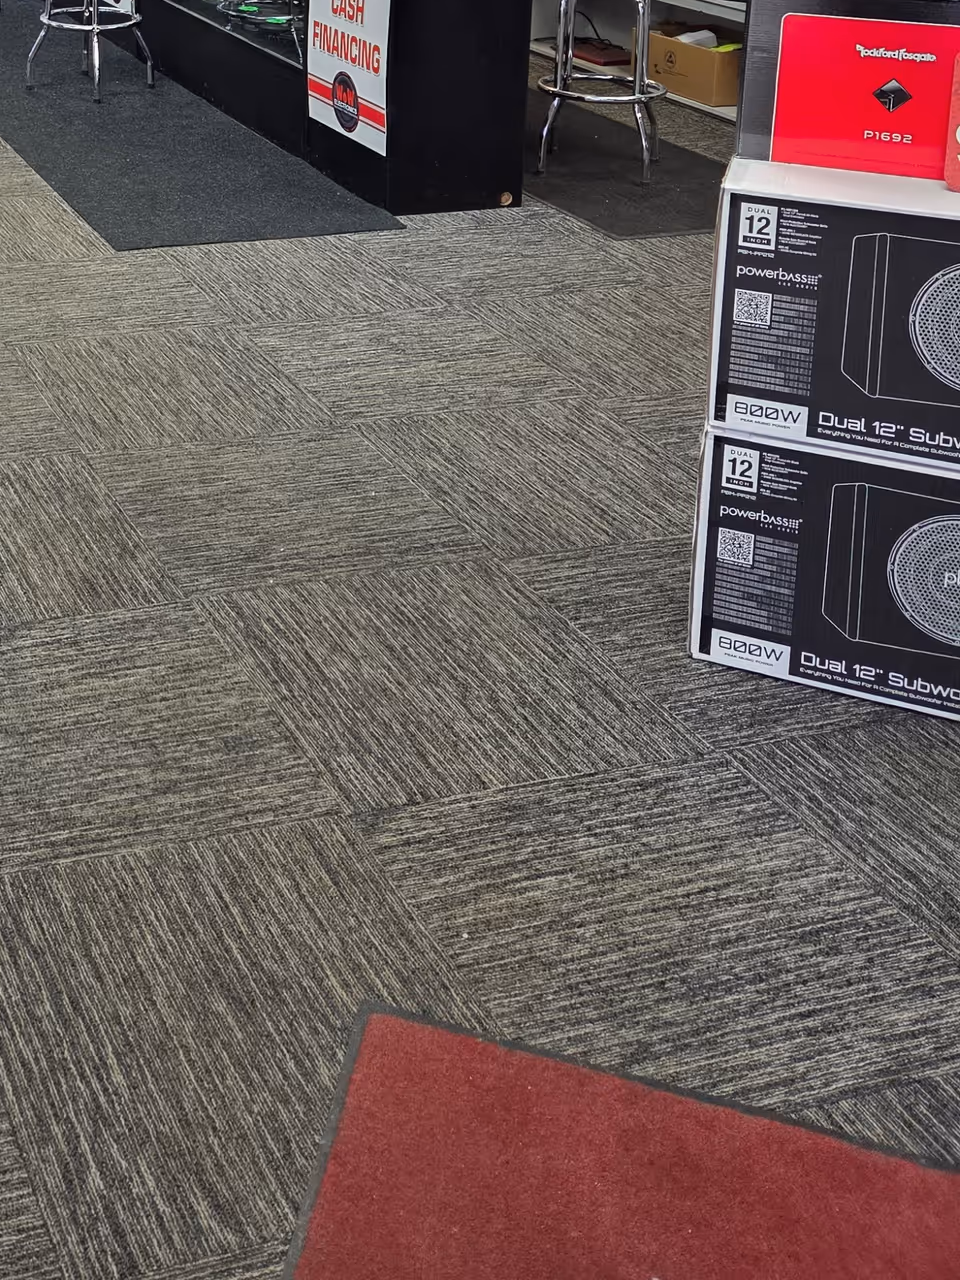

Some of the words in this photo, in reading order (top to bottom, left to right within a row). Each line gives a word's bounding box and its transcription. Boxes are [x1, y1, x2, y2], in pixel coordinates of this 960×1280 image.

[312, 20, 381, 76] FINANCING
[864, 130, 913, 144] P1692
[747, 206, 772, 215] DUAL
[745, 214, 771, 236] 12
[734, 401, 802, 424] 800W
[818, 411, 867, 433] Dual
[871, 421, 905, 438] 12"
[817, 427, 851, 439] Everything
[851, 433, 865, 441] You
[865, 436, 881, 444] Need
[899, 442, 930, 453] Complete
[730, 449, 754, 459] DUAL
[727, 457, 753, 479] 12
[729, 479, 750, 487] INCH
[718, 635, 784, 662] 800W
[755, 659, 774, 667] POWER
[799, 667, 832, 680] Everything
[832, 675, 845, 683] You
[845, 677, 861, 686] Need
[879, 685, 908, 698] Complete
[908, 692, 942, 705] Subwoofer
[800, 651, 848, 675] Dual
[852, 663, 884, 681] 12"
[888, 672, 960, 701] Subwo
